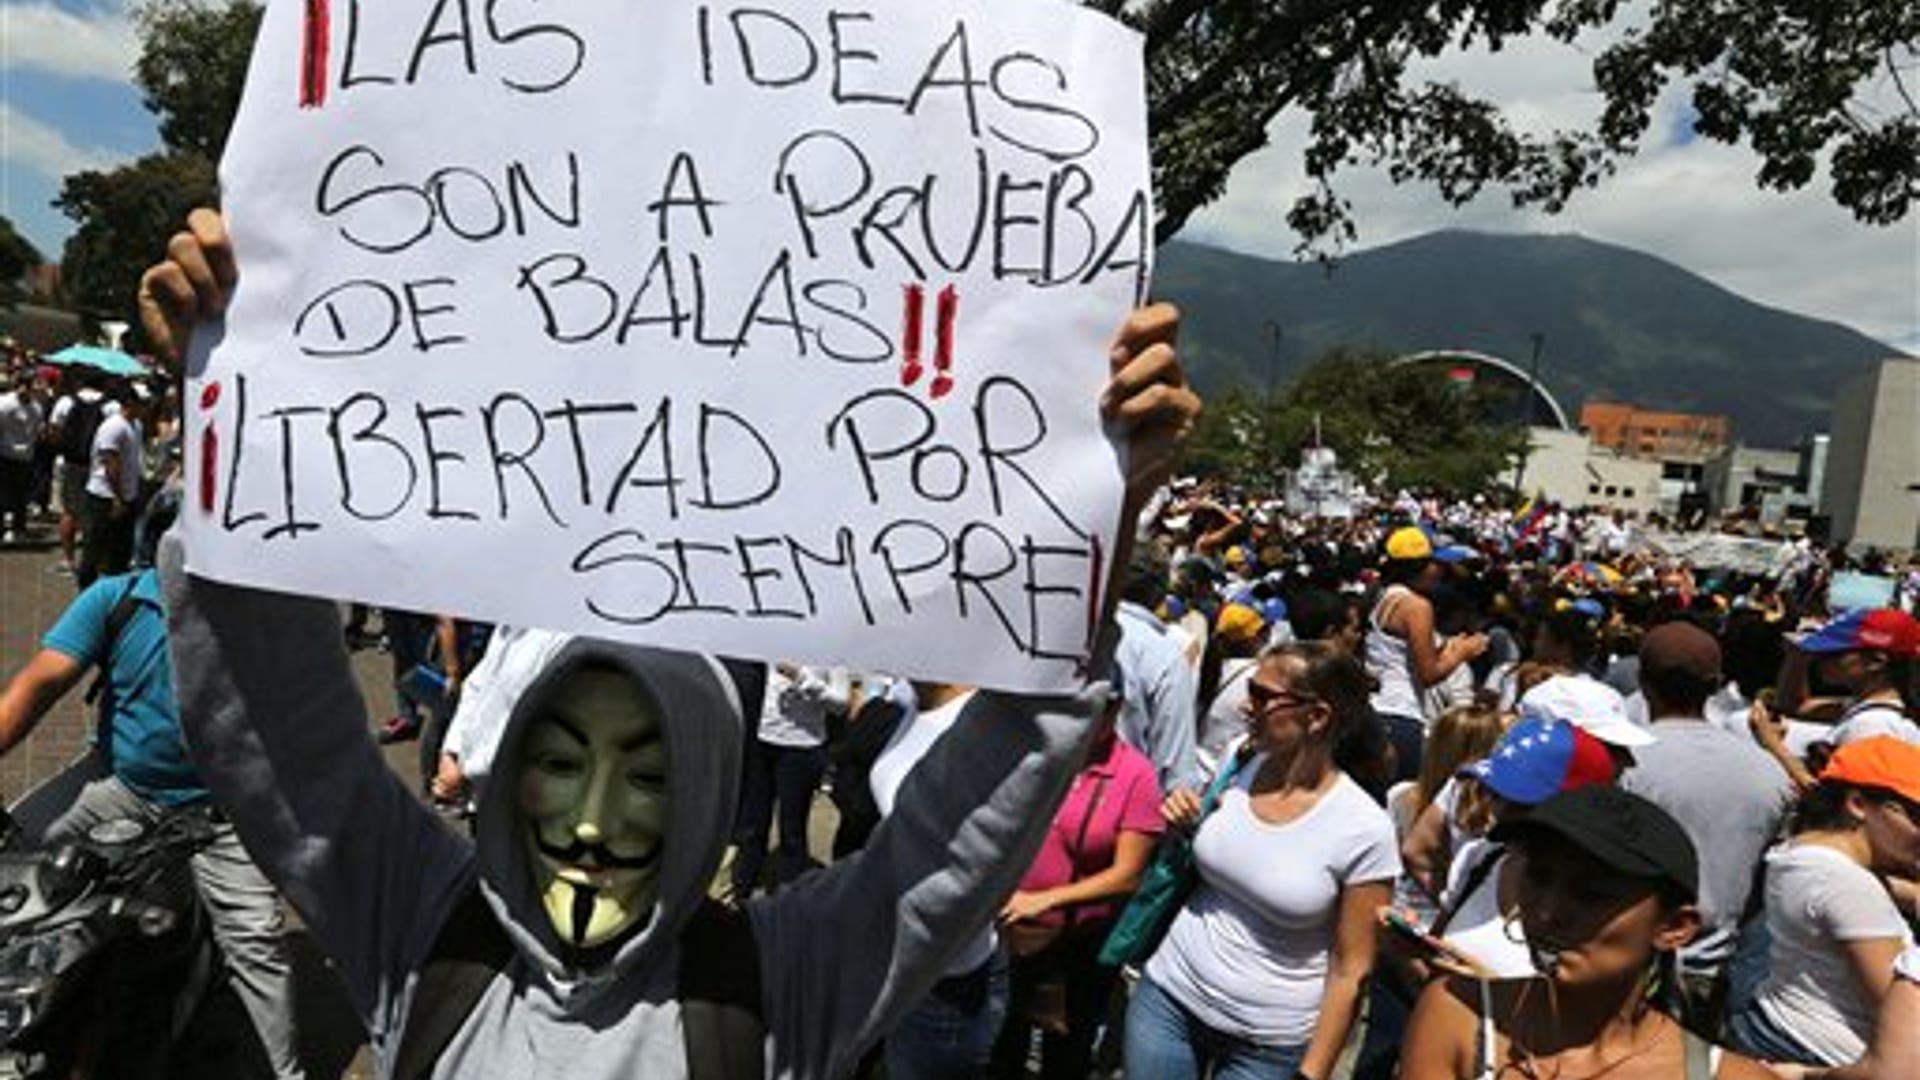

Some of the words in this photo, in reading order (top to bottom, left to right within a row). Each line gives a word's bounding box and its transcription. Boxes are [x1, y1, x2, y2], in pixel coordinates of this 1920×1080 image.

[698, 7, 1099, 161] IDEAS
[317, 145, 580, 253] SON
[648, 152, 726, 240] A
[775, 130, 1151, 308] PRUEBA
[295, 279, 466, 357] DE
[516, 246, 958, 398] BALAS!!
[199, 374, 781, 540] ¡LIBERTAD
[572, 519, 1103, 679] SIEMPRE!
